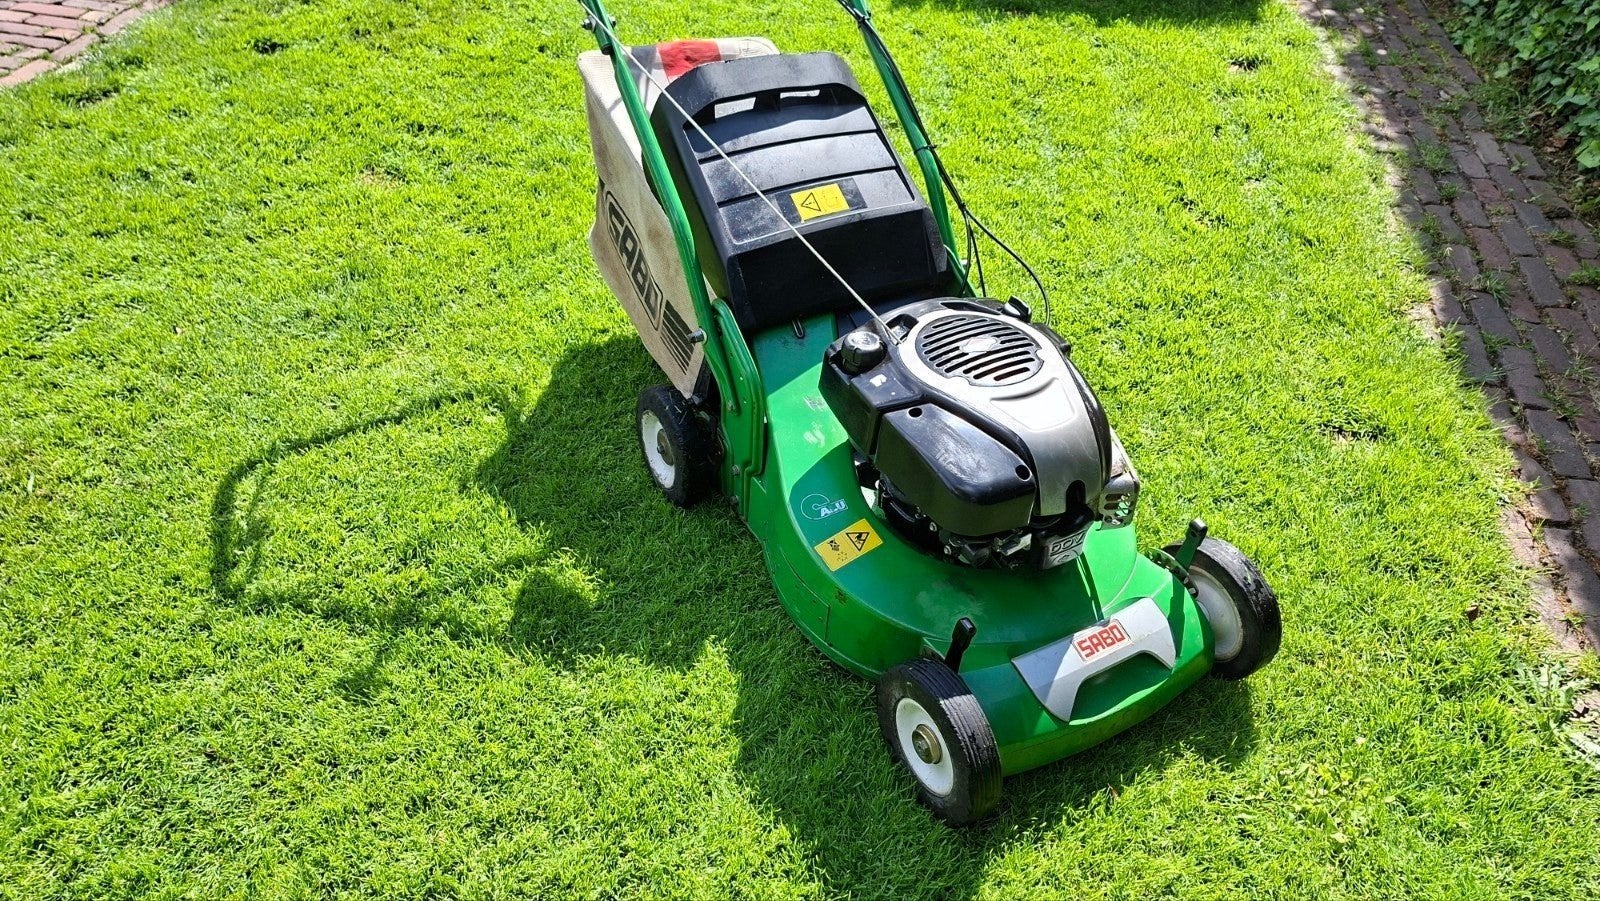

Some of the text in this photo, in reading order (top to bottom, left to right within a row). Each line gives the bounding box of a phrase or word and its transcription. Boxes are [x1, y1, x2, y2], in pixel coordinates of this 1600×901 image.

[608, 201, 659, 321] SABO
[1051, 532, 1086, 555] DOV
[1076, 624, 1126, 658] SABO
